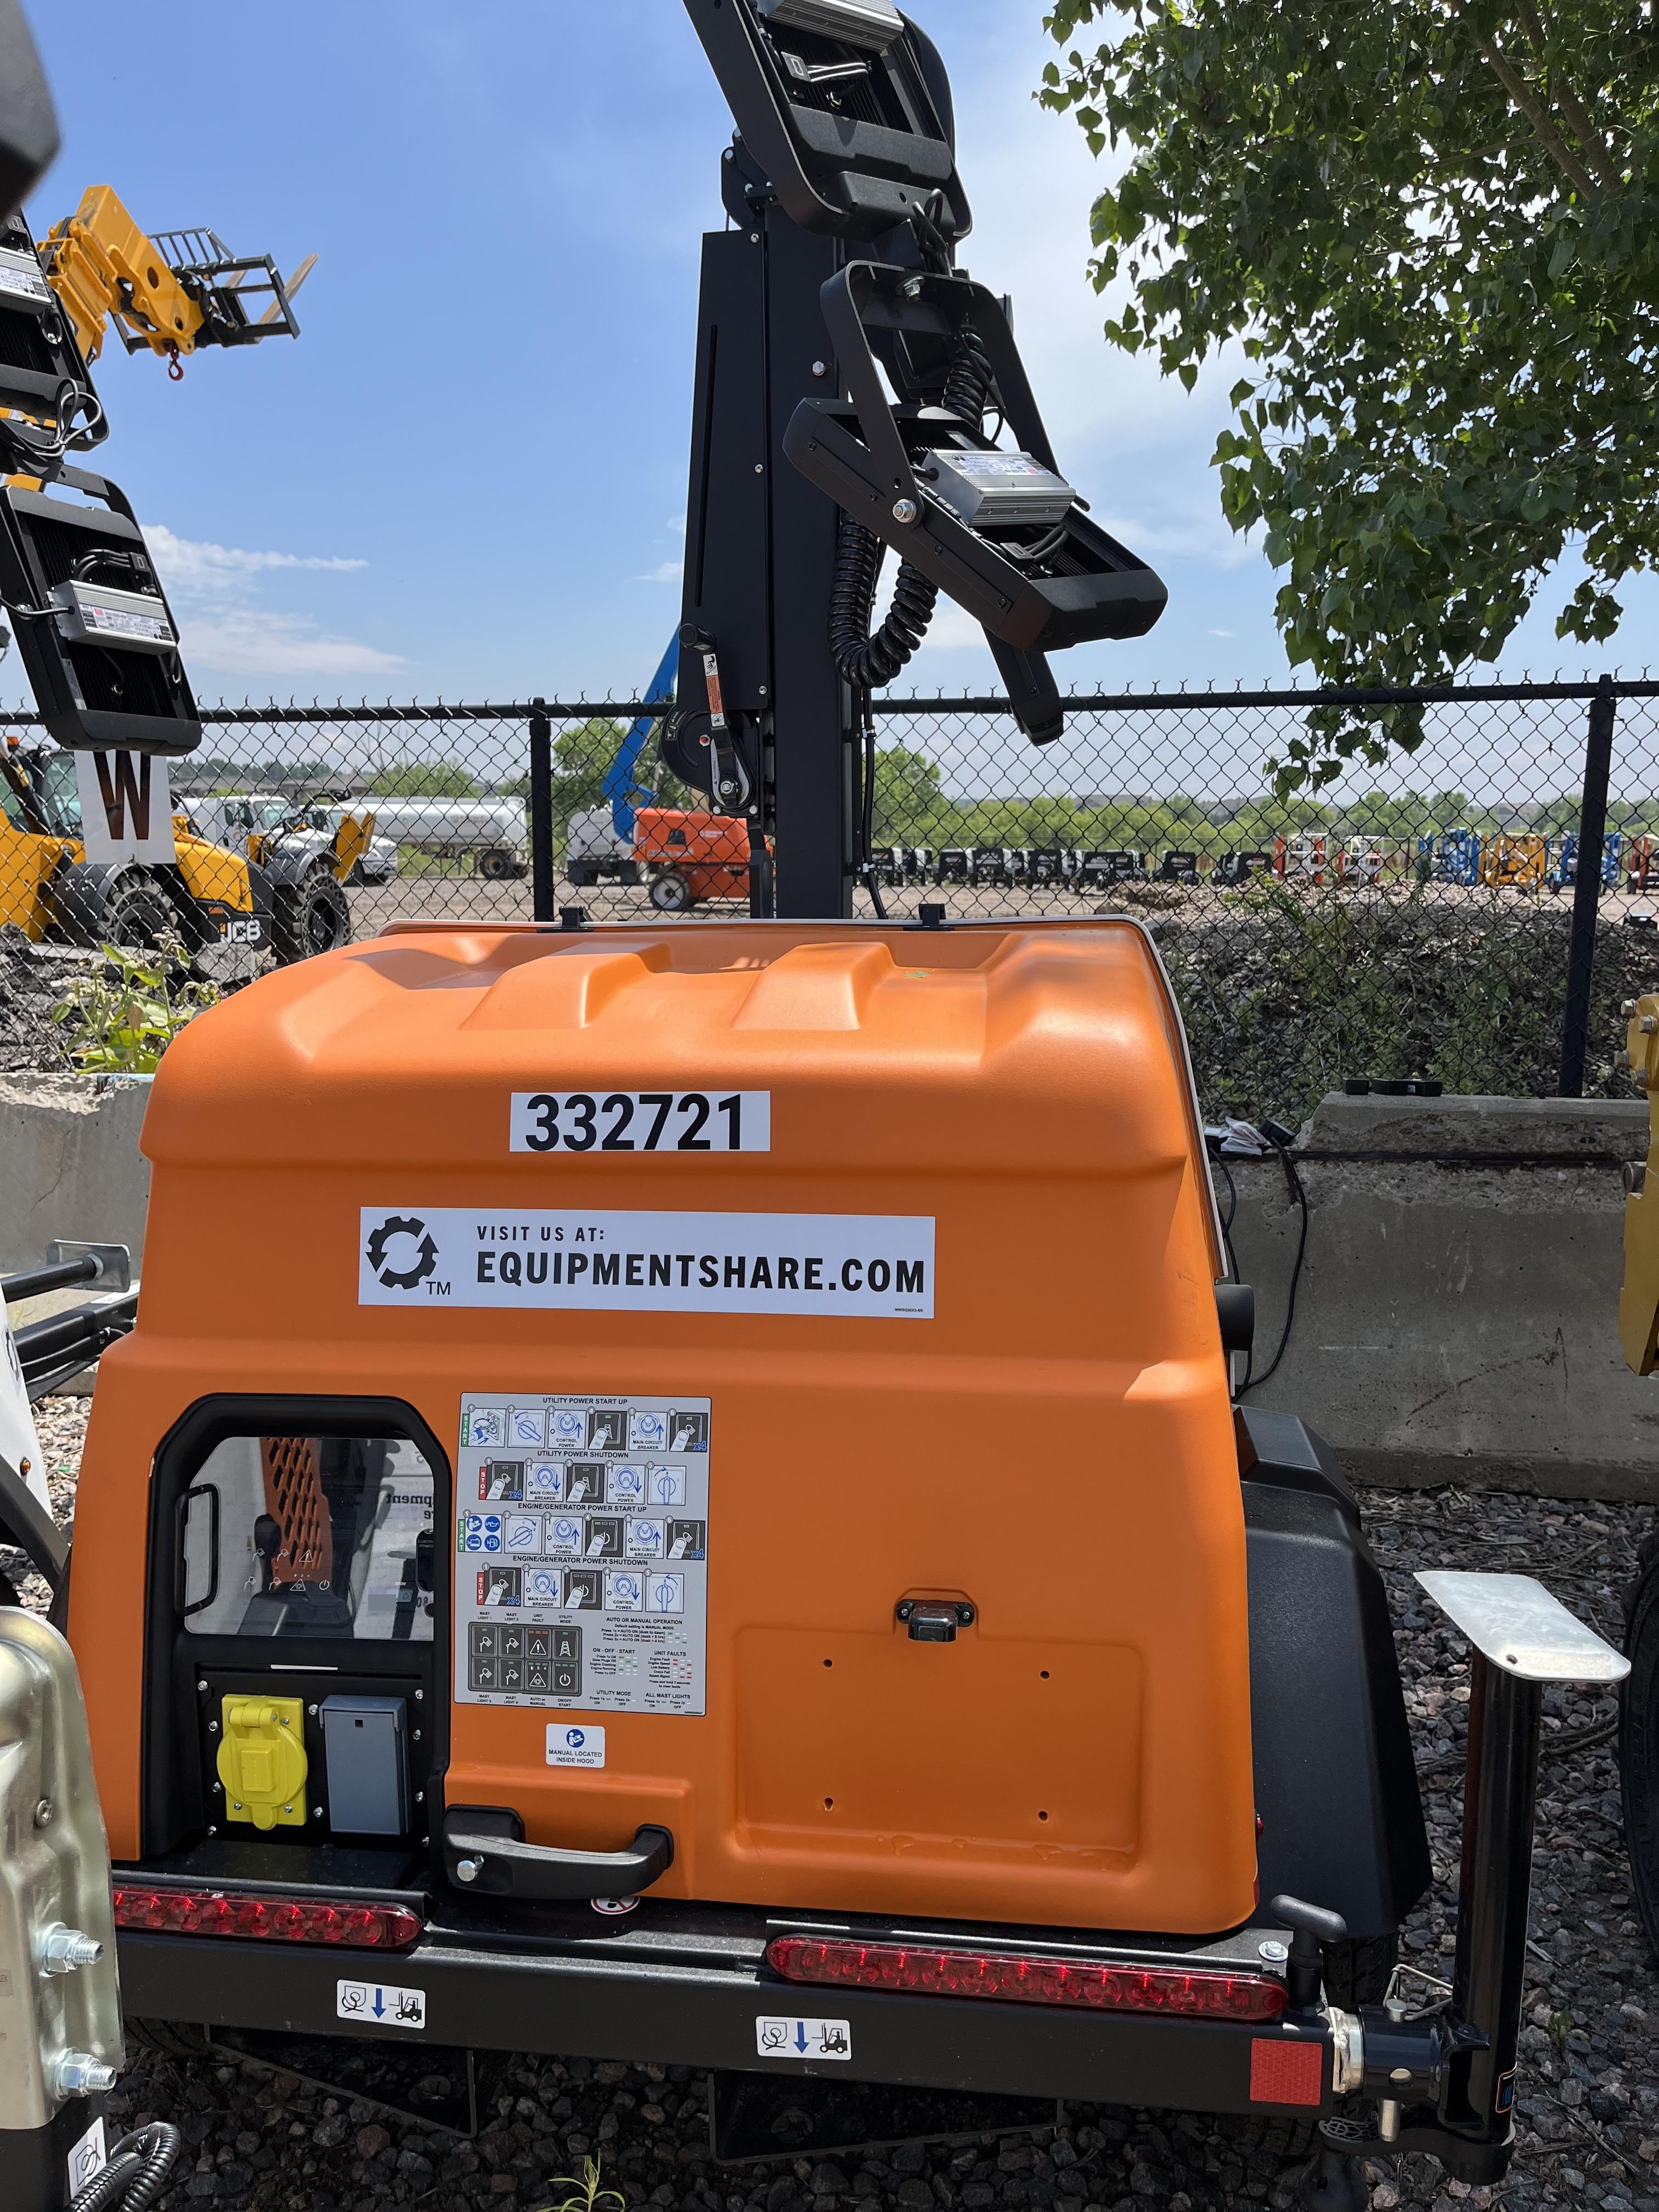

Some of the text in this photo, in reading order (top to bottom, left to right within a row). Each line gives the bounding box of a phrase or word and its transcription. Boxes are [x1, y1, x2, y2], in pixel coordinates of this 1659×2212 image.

[93, 750, 150, 839] W
[221, 919, 261, 944] JCB
[526, 1093, 741, 1151] 332721
[477, 1226, 604, 1242] VISIT US AT:
[426, 1282, 450, 1295] TM
[477, 1251, 924, 1293] EQUIPMENTSHARE.COM
